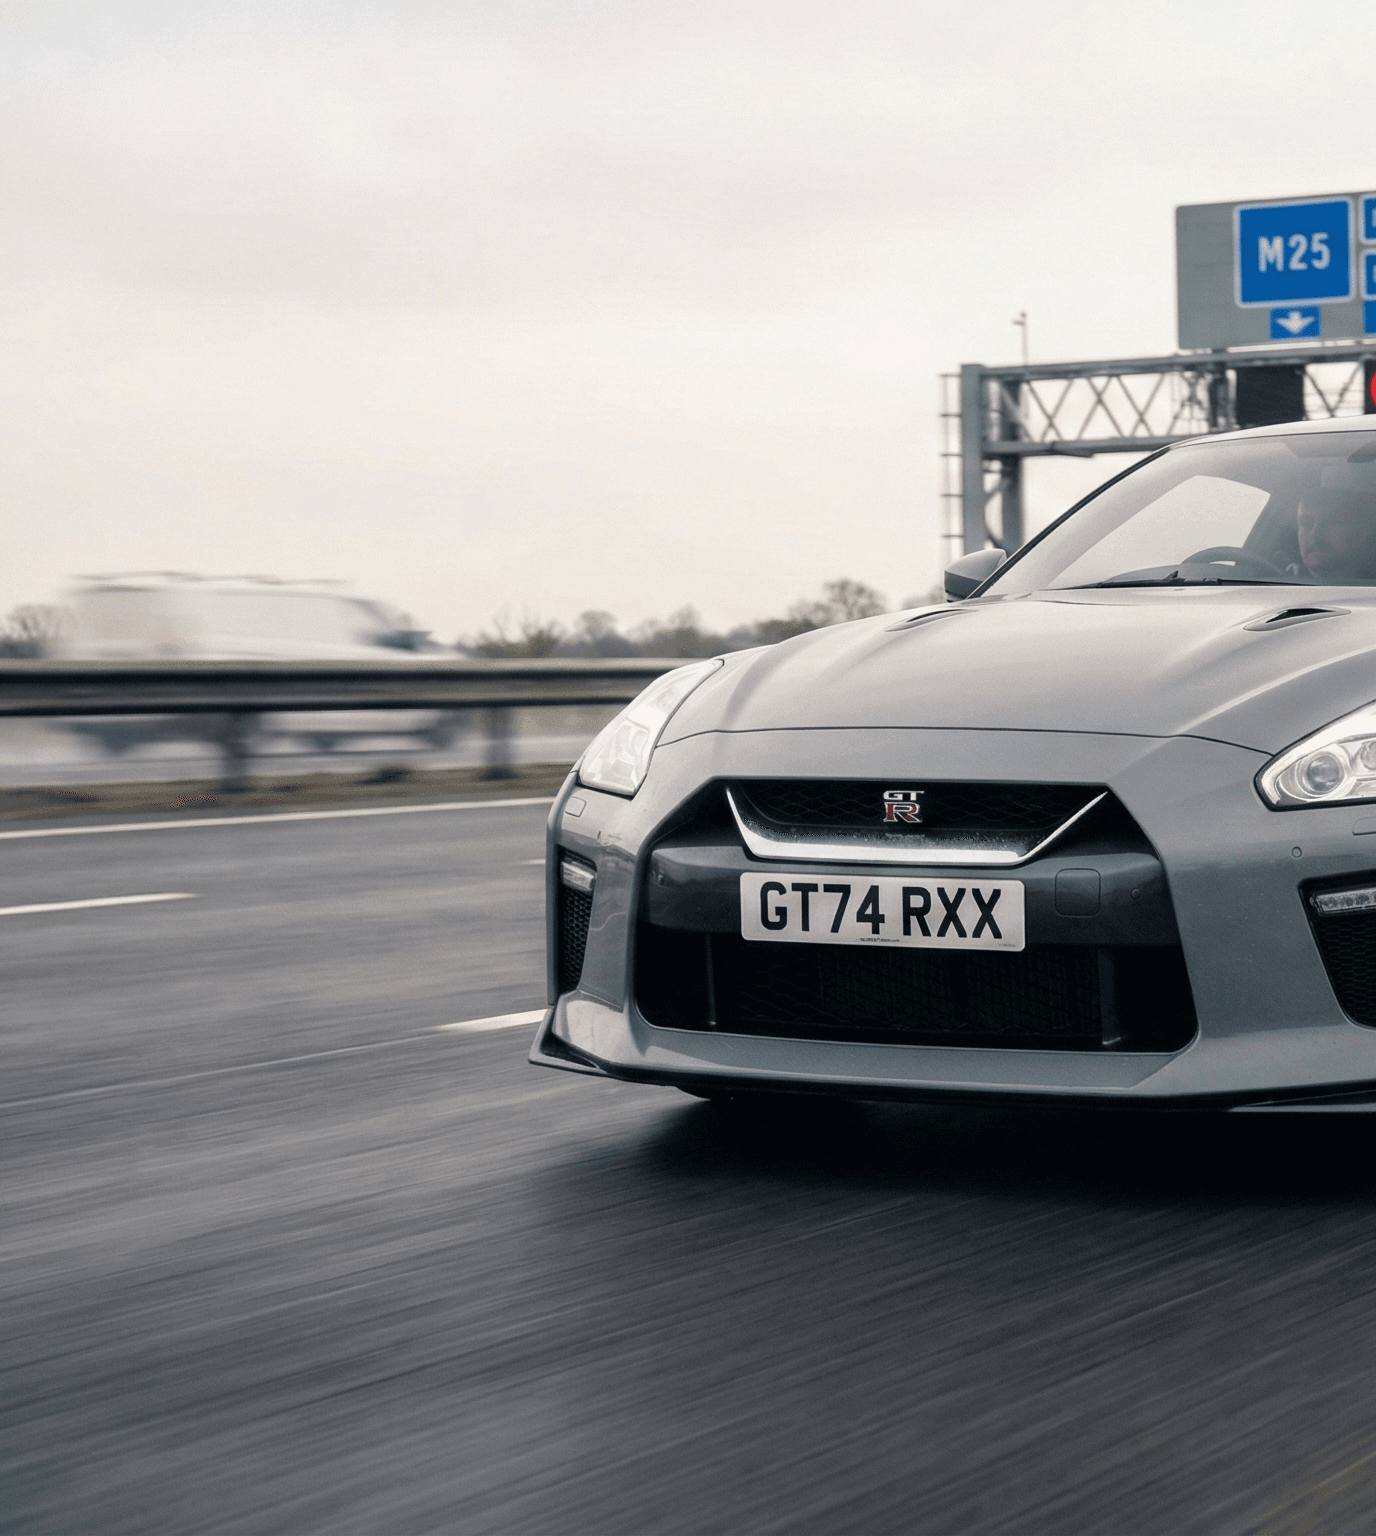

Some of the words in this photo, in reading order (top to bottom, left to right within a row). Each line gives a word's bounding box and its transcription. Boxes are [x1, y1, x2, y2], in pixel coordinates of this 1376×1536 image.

[1258, 232, 1331, 272] M25
[883, 790, 924, 800] GT
[883, 801, 922, 823] R
[760, 881, 885, 935] GT74
[902, 886, 1003, 939] RXX
